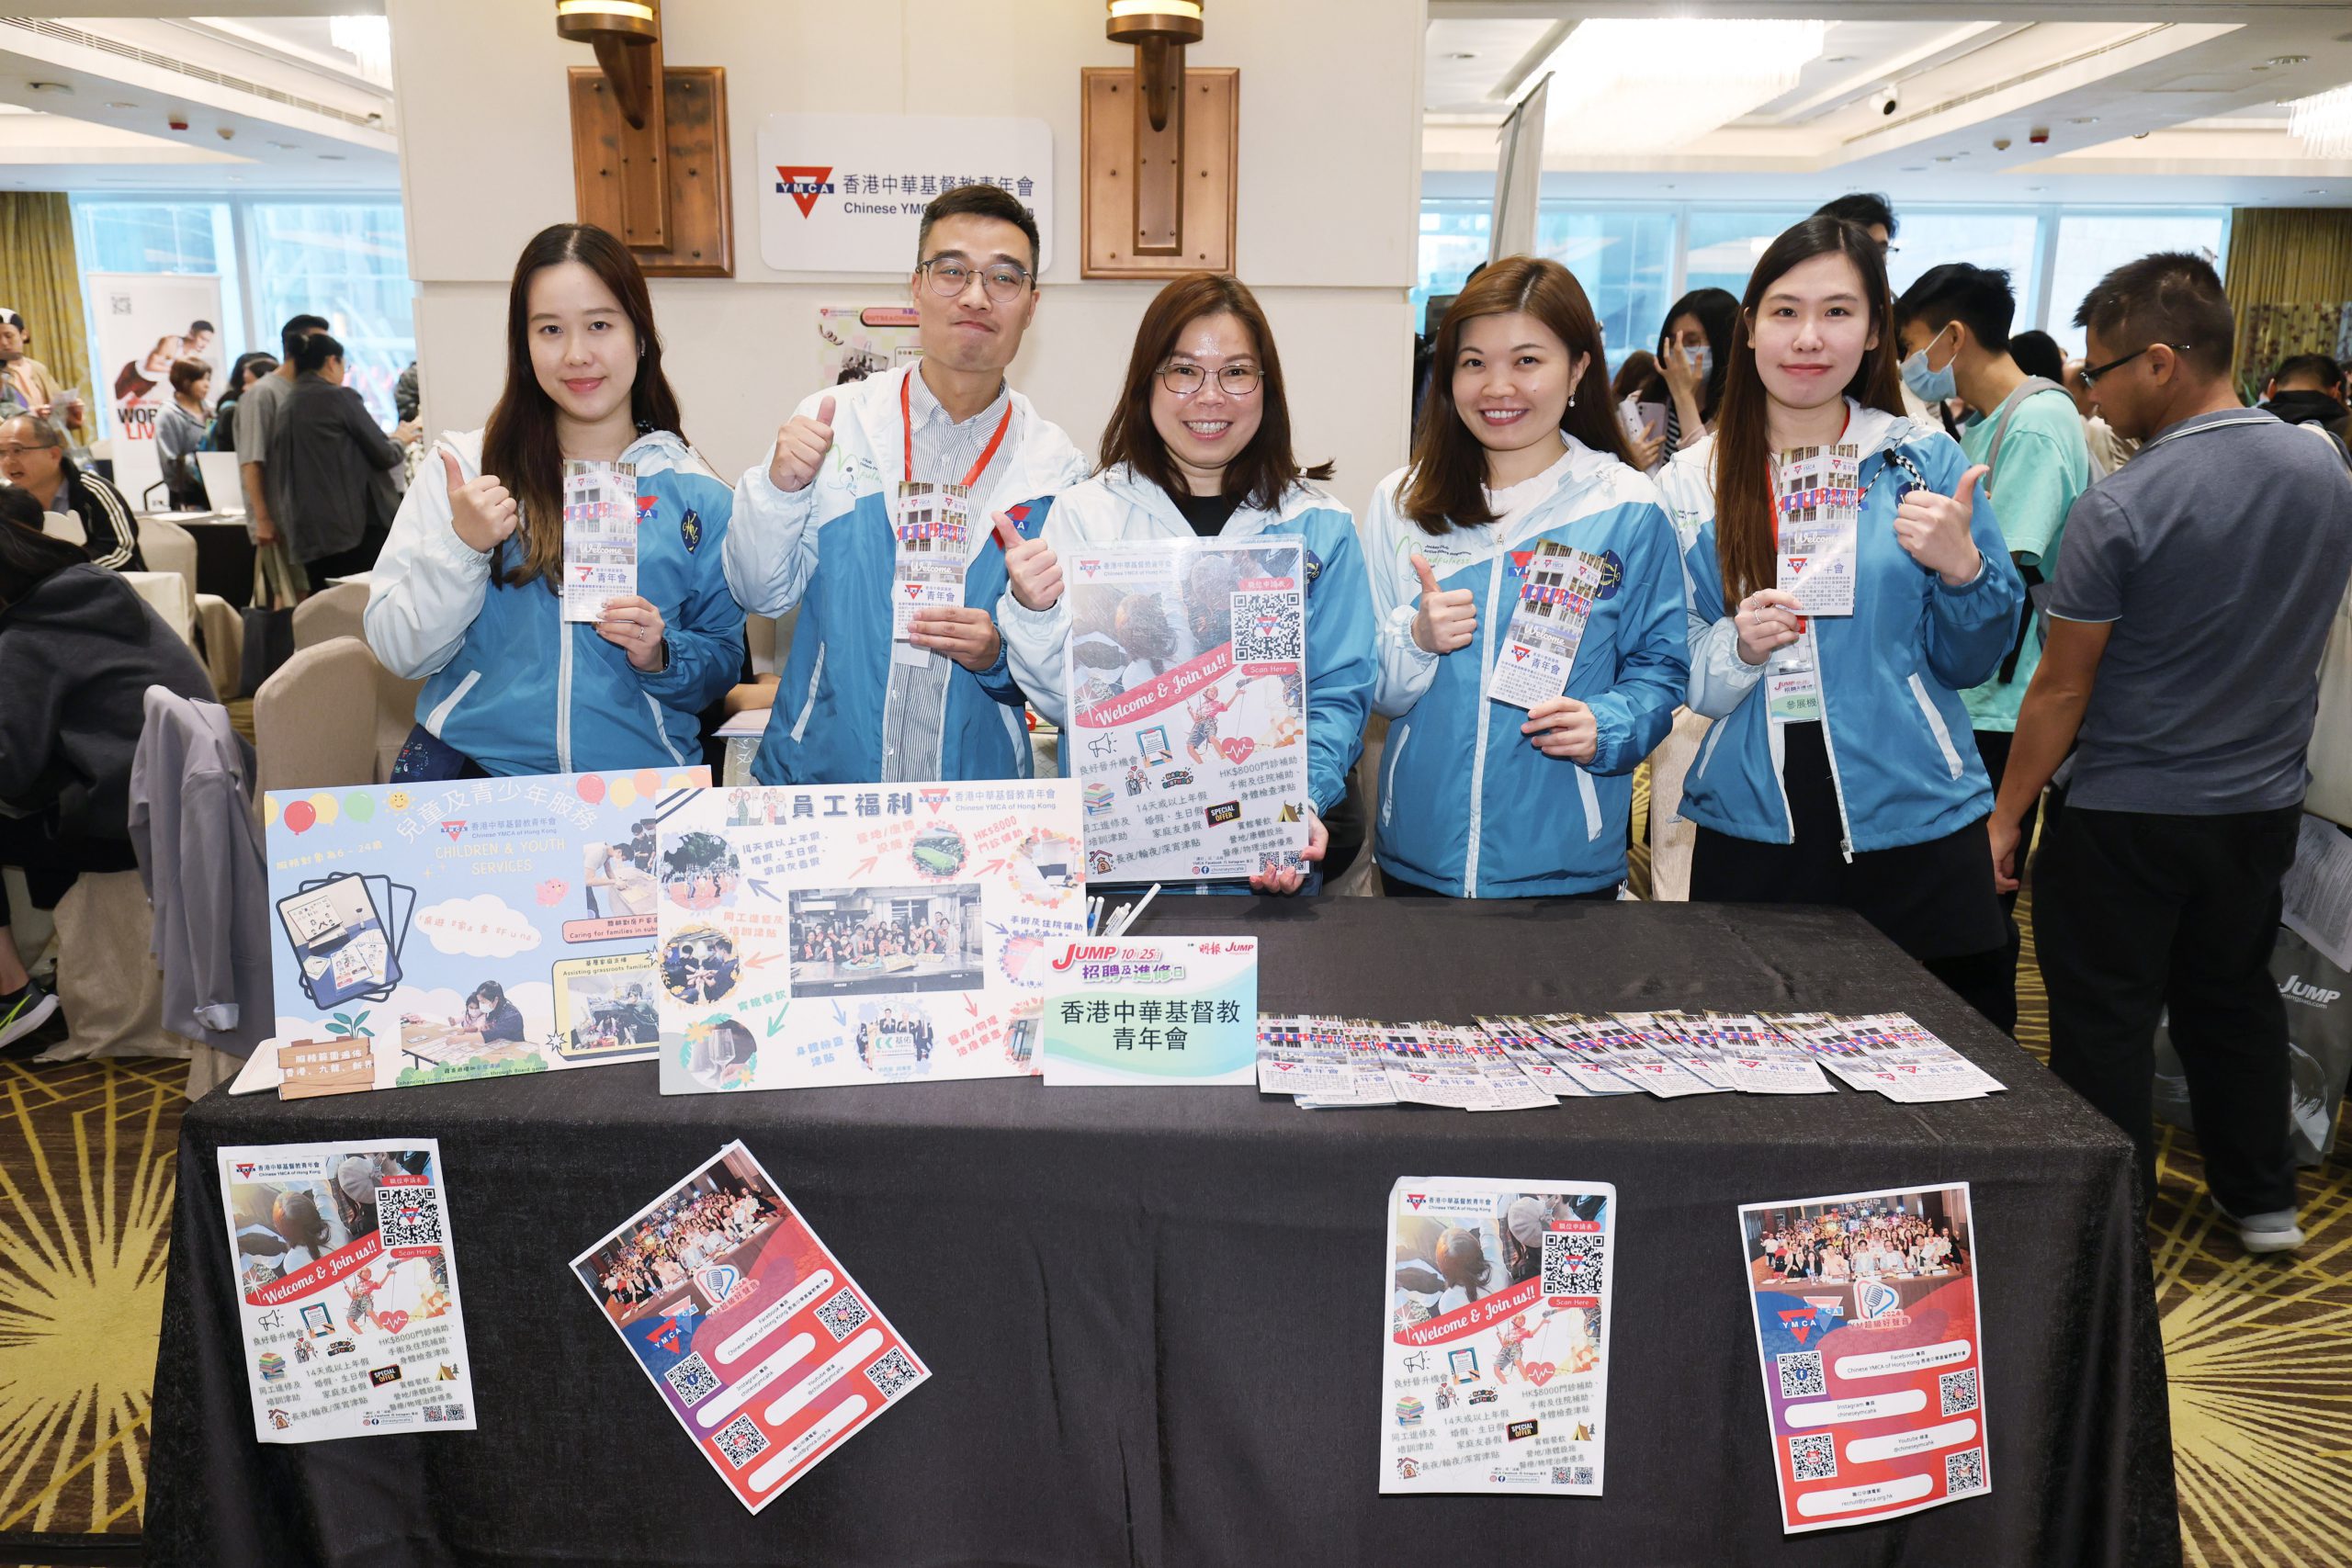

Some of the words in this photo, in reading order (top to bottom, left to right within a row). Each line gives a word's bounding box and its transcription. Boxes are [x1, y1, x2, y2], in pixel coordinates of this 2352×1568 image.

[781, 183, 830, 195] YMCA
[844, 202, 897, 214] Chinese
[900, 203, 928, 215] YMC
[1794, 530, 1838, 545] Welcom
[580, 542, 625, 556] Welcome
[910, 559, 953, 574] Welcome
[597, 571, 628, 584] 青年會
[926, 591, 956, 603] 青年會
[1524, 624, 1566, 645] Welcome
[1250, 665, 1269, 674] Scan
[1270, 664, 1287, 673] Here
[1531, 658, 1561, 675] 青年會
[1095, 691, 1157, 727] Welcome
[1157, 682, 1170, 698] &
[1171, 667, 1203, 695] Join
[1202, 653, 1227, 677] us!!
[1164, 770, 1190, 781] HAPPY
[955, 788, 1056, 803] 香港中華基督教青年會
[792, 792, 914, 818] 員工福利
[956, 804, 984, 812] Chinese
[985, 803, 1007, 811] YMCA
[1017, 803, 1035, 811] Hong
[1037, 801, 1057, 810] Kong
[1210, 805, 1236, 818] SPECIAL
[396, 781, 597, 844] 兒童及青少年服務
[1215, 811, 1234, 822] OFFER
[435, 842, 499, 860] CHILDREN
[503, 841, 514, 854] &
[521, 838, 566, 853] YOUTH
[471, 859, 533, 875] SERVICES
[570, 931, 592, 940] Caring
[1198, 942, 1222, 955] 明報
[1225, 941, 1255, 953] JUMP
[1051, 942, 1117, 970] JUMP
[562, 968, 592, 976] Assisting
[593, 965, 625, 974] grassroots
[1081, 964, 1186, 981] 招聘及進修日
[2277, 974, 2341, 1003] JUMP
[1060, 999, 1241, 1024] 香港中華基督教
[1113, 1026, 1189, 1052] 青年會
[396, 1078, 425, 1087] Enhancing
[390, 1177, 424, 1186] 職位申請表
[1558, 1222, 1593, 1231] 職位申請表
[416, 1247, 432, 1256] Here
[262, 1273, 315, 1305] Welcome
[316, 1266, 326, 1280] &
[329, 1255, 356, 1277] Join
[356, 1240, 378, 1262] us!!
[1573, 1298, 1589, 1306] Here
[758, 1304, 781, 1325] Facebook
[1412, 1317, 1468, 1346] Welcome
[1470, 1309, 1481, 1324] &
[1485, 1298, 1511, 1321] Join
[1512, 1285, 1536, 1306] us!!
[1782, 1318, 1816, 1329] YMCA
[654, 1326, 683, 1350] YMCA
[727, 1338, 749, 1358] Chinese
[746, 1330, 761, 1346] YMCA
[762, 1318, 777, 1335] Hong
[774, 1311, 789, 1326] Kong
[1889, 1352, 1916, 1360] Facebook
[1847, 1364, 1869, 1373] Chinese
[1870, 1362, 1885, 1371] YMCA
[1892, 1360, 1906, 1371] Hong
[1905, 1359, 1920, 1368] Kong
[374, 1369, 396, 1380] SPECIAL
[379, 1373, 395, 1383] OFFER
[736, 1371, 761, 1393] Instagram
[1837, 1401, 1865, 1412] Instagram
[1510, 1423, 1533, 1433] SPECIAL
[1515, 1428, 1532, 1438] OFFER
[1898, 1436, 1919, 1445] Youtube
